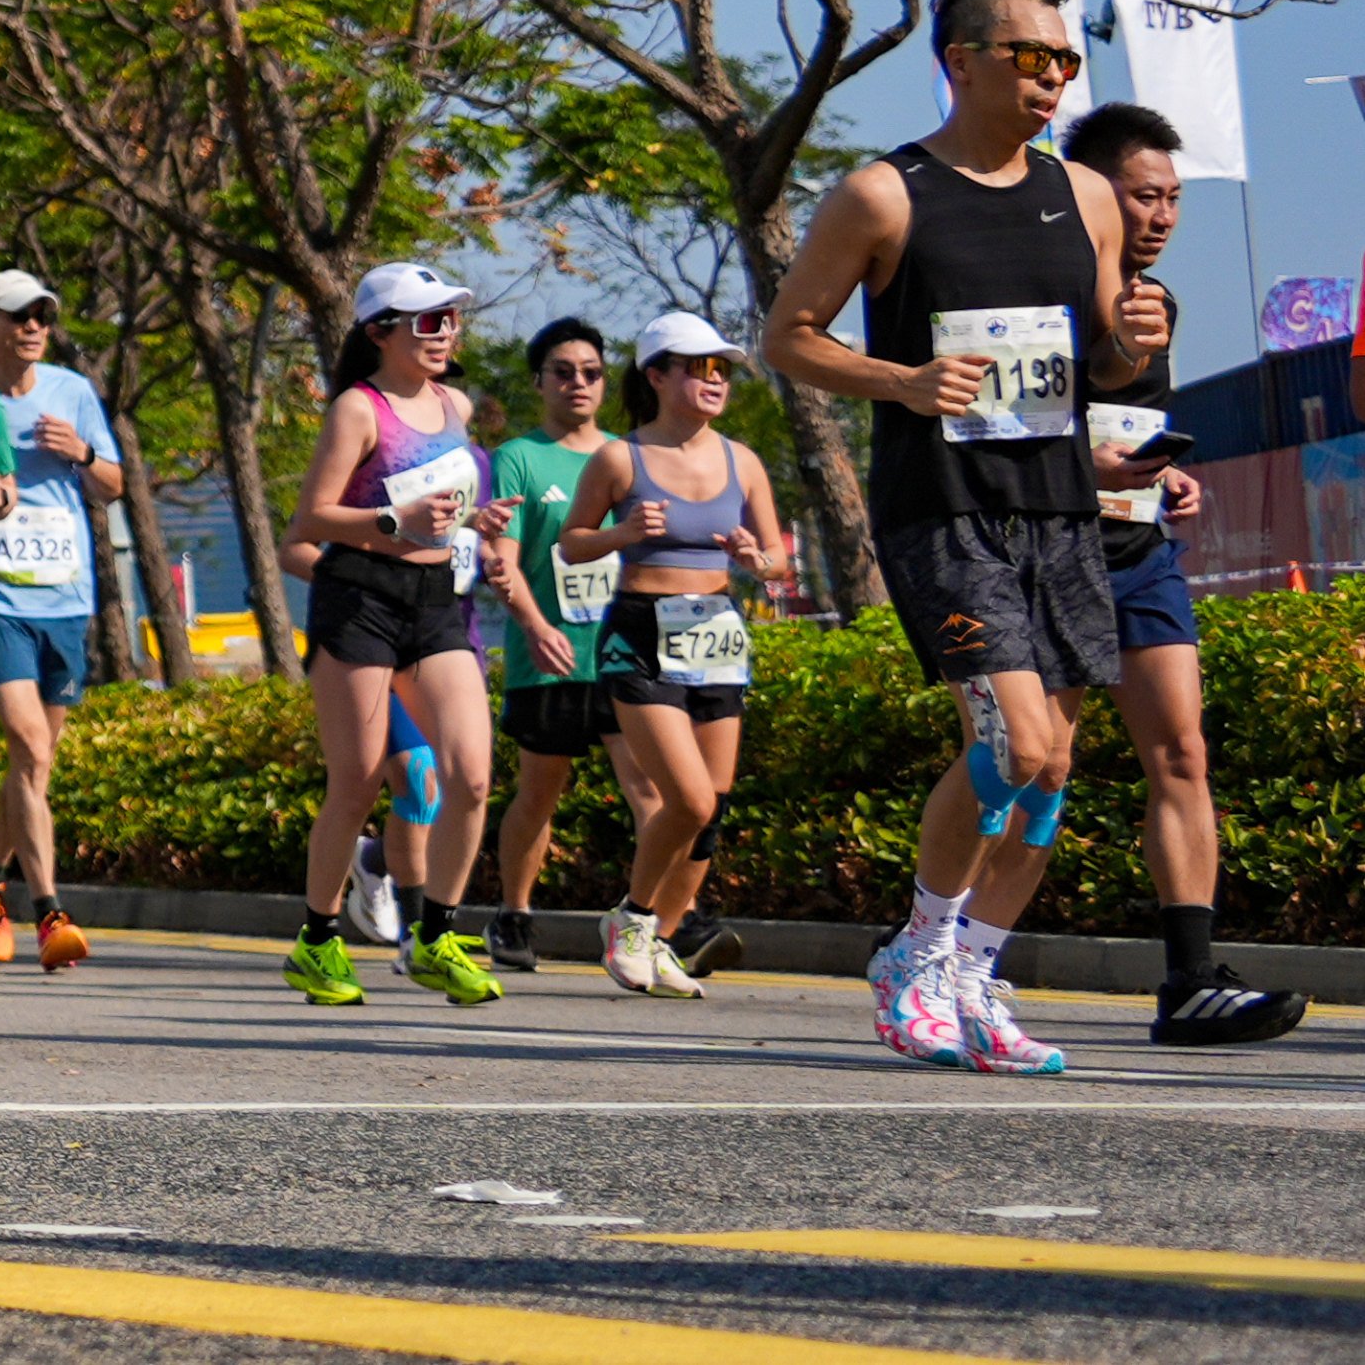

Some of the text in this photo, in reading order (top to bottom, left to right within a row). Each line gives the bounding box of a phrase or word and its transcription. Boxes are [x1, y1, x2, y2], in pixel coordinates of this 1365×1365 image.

[1143, 0, 1193, 30] TVB
[973, 357, 1067, 401] 1138
[665, 630, 745, 659] E7249
